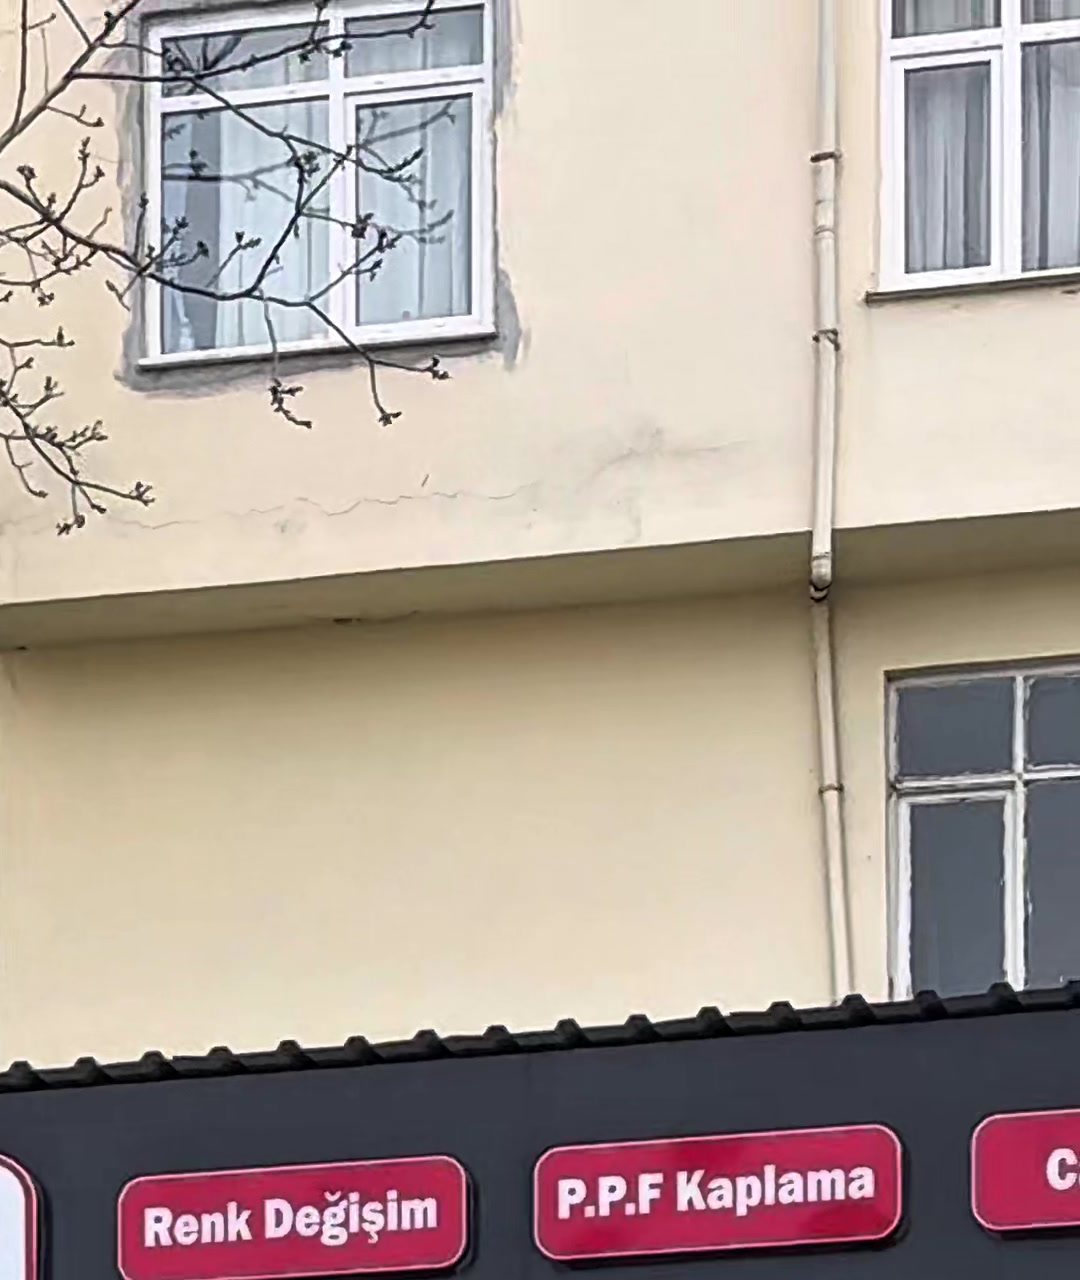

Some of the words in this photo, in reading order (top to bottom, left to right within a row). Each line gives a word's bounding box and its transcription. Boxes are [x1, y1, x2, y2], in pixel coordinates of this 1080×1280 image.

[558, 1172, 664, 1219] P.P.F
[676, 1162, 876, 1217] Kaplama
[1046, 1148, 1080, 1191] C
[144, 1201, 252, 1247] Renk
[265, 1189, 438, 1246] Değişim
